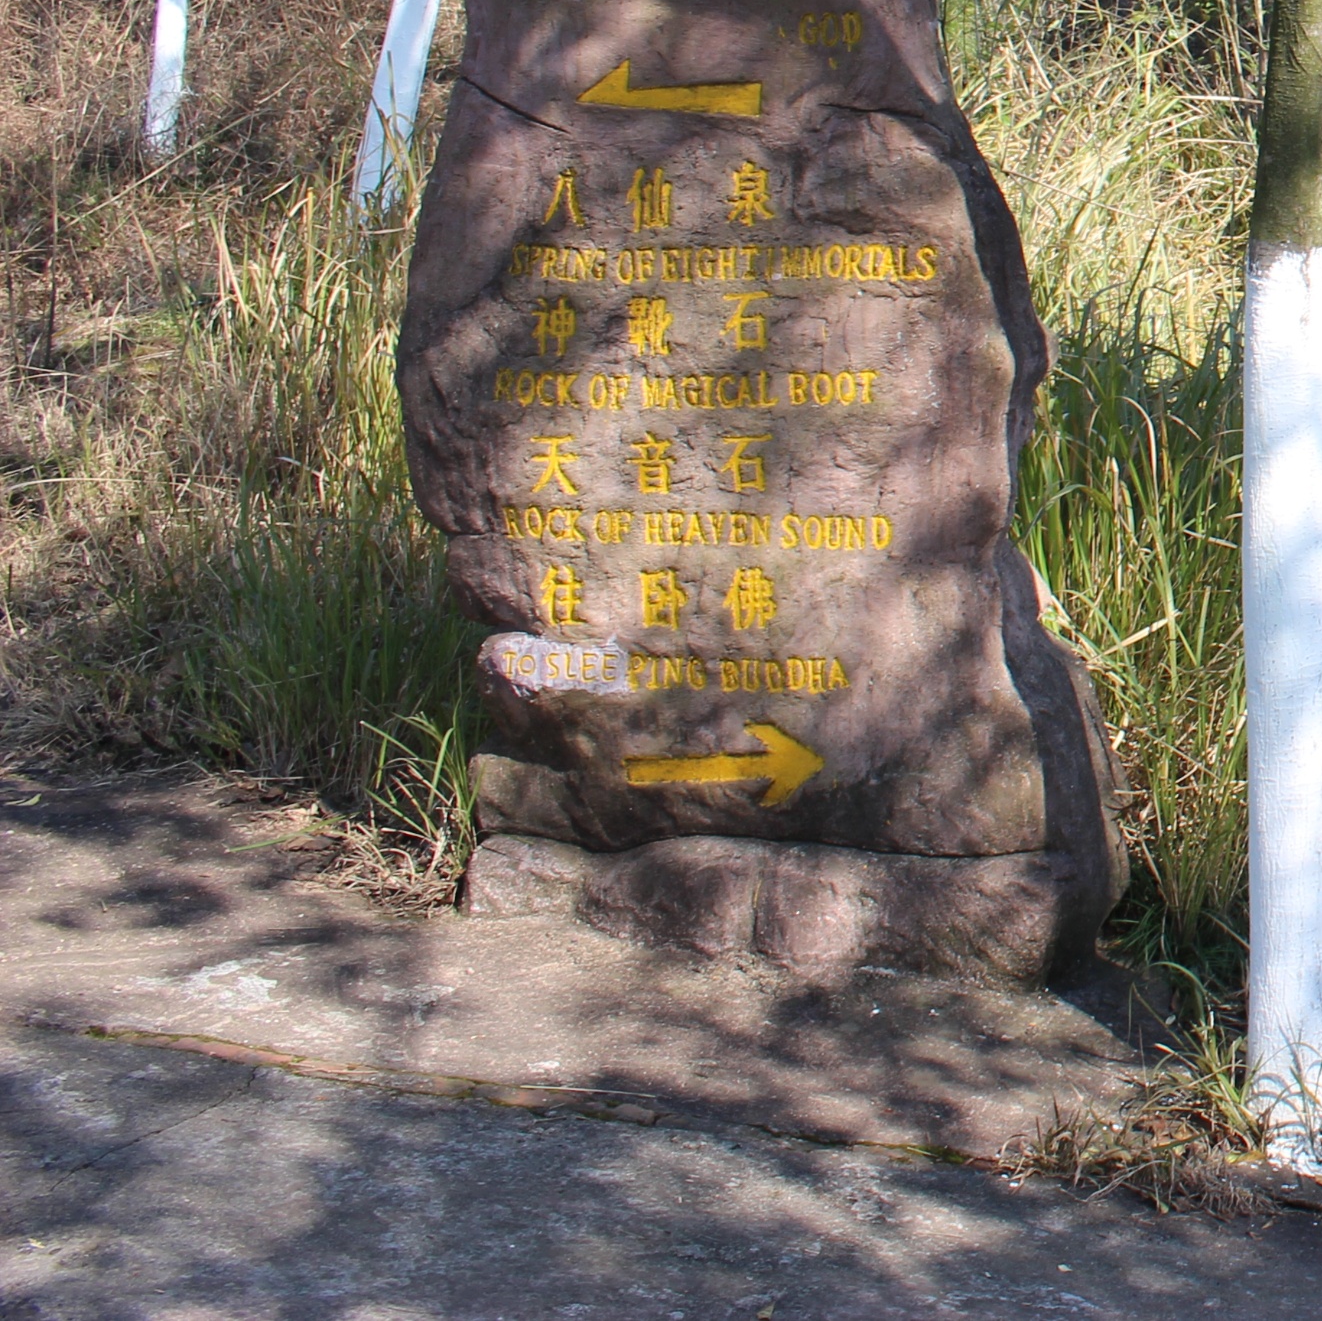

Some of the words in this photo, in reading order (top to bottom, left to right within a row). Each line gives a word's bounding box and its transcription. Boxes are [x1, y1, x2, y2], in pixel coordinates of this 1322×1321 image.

[799, 11, 863, 49] GOD
[543, 161, 775, 233] 八仙泉
[509, 243, 606, 282] SPRING
[616, 245, 656, 284] OF
[661, 244, 762, 282] EIGHT
[765, 242, 938, 282] IMMORTALS
[494, 369, 580, 409] ROCK
[588, 372, 631, 411] OF
[641, 370, 779, 410] MAGICAL
[788, 370, 879, 407] BOOT
[530, 432, 773, 496] 天音石
[501, 505, 586, 544] ROCK
[592, 508, 634, 545] OF
[643, 510, 772, 547] HEAVEN
[780, 513, 893, 551] SOUND
[538, 564, 778, 631] 往卧佛
[501, 650, 537, 678] TO
[544, 650, 707, 692] SLEEPING
[720, 656, 852, 694] BUDDHA
